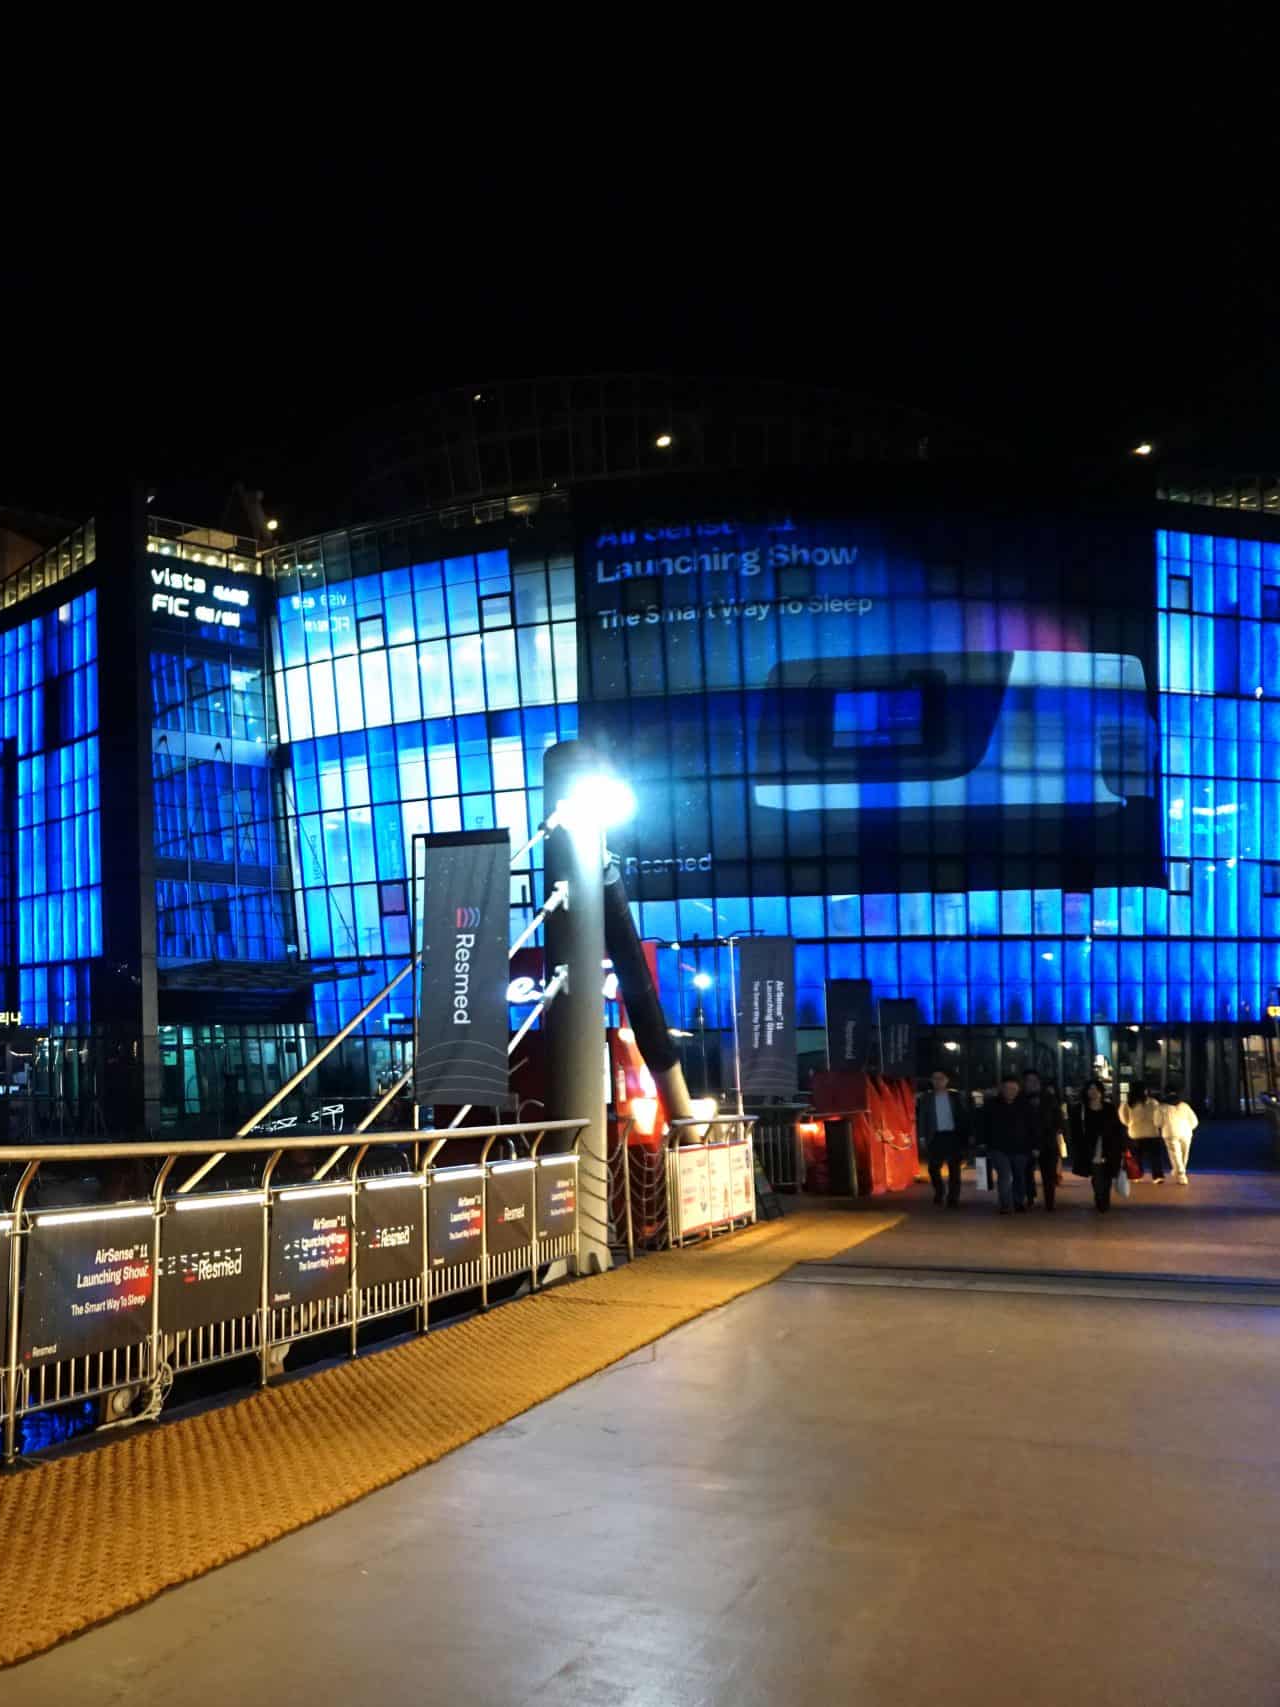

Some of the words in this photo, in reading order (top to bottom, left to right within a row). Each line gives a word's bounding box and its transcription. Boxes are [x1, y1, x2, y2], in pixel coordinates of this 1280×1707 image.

[596, 546, 761, 584] Launching
[769, 543, 858, 569] Show
[150, 567, 206, 594] vista
[151, 592, 190, 618] FIC
[597, 609, 641, 630] The
[720, 598, 770, 624] Way
[776, 597, 803, 615] To
[806, 592, 873, 616] Sleep
[453, 933, 476, 1025] Resmed
[139, 1243, 149, 1258] 11
[76, 1267, 122, 1289] Launching
[122, 1265, 150, 1281] Show
[198, 1253, 243, 1281] Resmed
[71, 1303, 84, 1317] The
[84, 1300, 106, 1314] Smart
[106, 1297, 121, 1312] Way
[127, 1293, 146, 1306] Sleep
